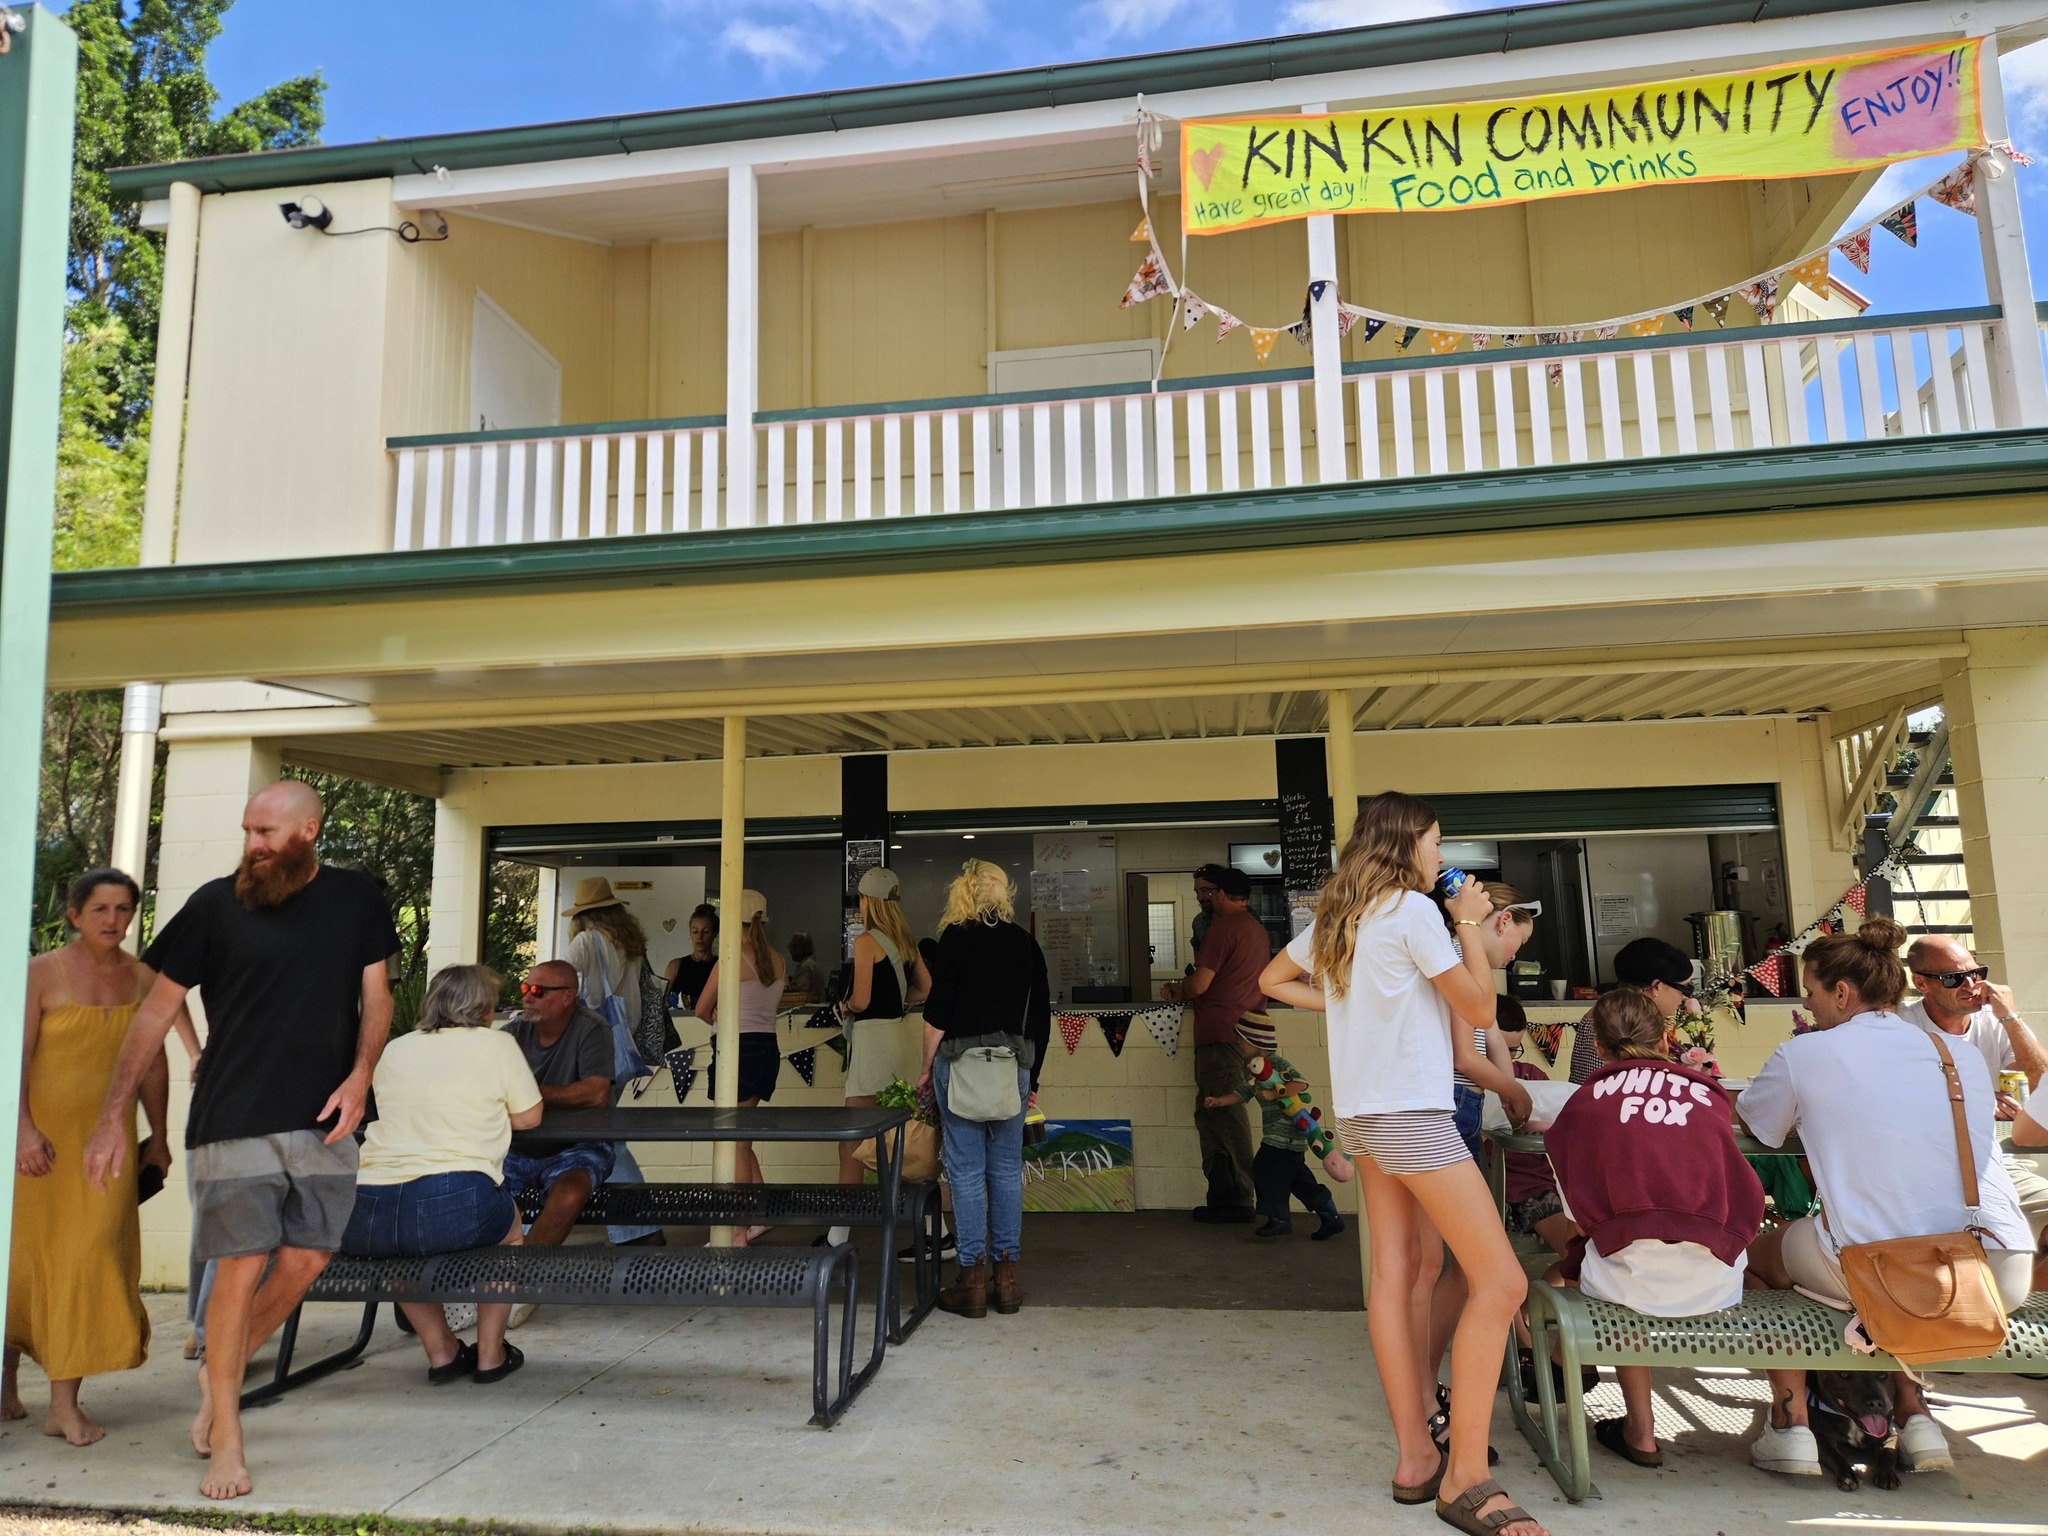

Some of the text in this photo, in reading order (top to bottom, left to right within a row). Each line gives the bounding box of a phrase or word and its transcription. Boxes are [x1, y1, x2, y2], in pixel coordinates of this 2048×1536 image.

[1841, 46, 1965, 135] ENJOY!!
[1241, 69, 1836, 191] KIN KIN COMMUNITY
[1389, 160, 1502, 212] Food
[1513, 157, 1575, 191] and
[1194, 196, 1243, 225] Have
[1252, 182, 1312, 217] great
[1282, 792, 1307, 803] Works
[1286, 801, 1311, 812] Burger
[1283, 825, 1311, 836] Sausage
[1294, 812, 1311, 824] $12
[1289, 861, 1318, 871] Burger
[1593, 1068, 1713, 1107] WHITE
[1620, 1096, 1694, 1127] FOX
[1060, 1143, 1113, 1182] KIN
